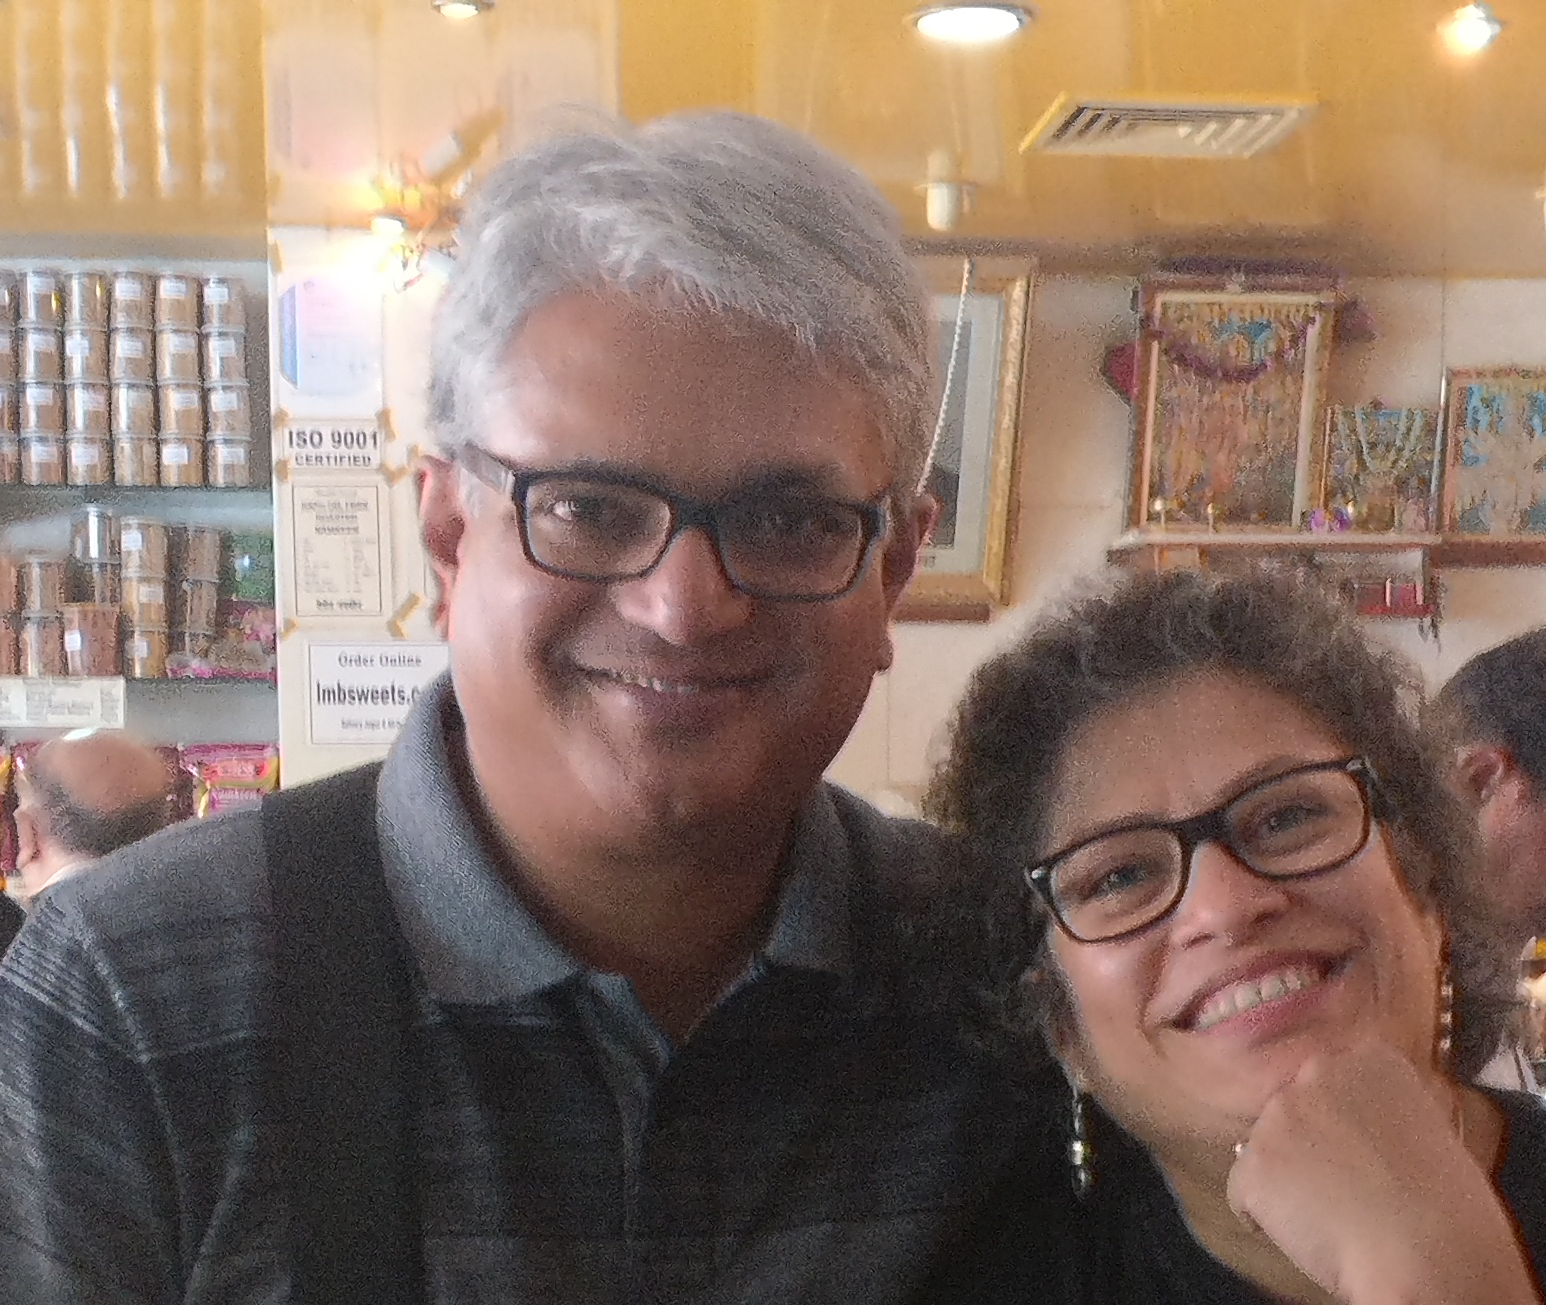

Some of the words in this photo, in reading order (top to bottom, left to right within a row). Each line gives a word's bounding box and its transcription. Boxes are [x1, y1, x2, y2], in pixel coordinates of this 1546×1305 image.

[288, 430, 324, 450] ISO
[331, 430, 379, 450] 9001
[294, 453, 372, 467] CERTIFIED
[337, 650, 375, 668] Order
[379, 651, 422, 668] Online
[316, 679, 421, 706] lmbsweets.c
